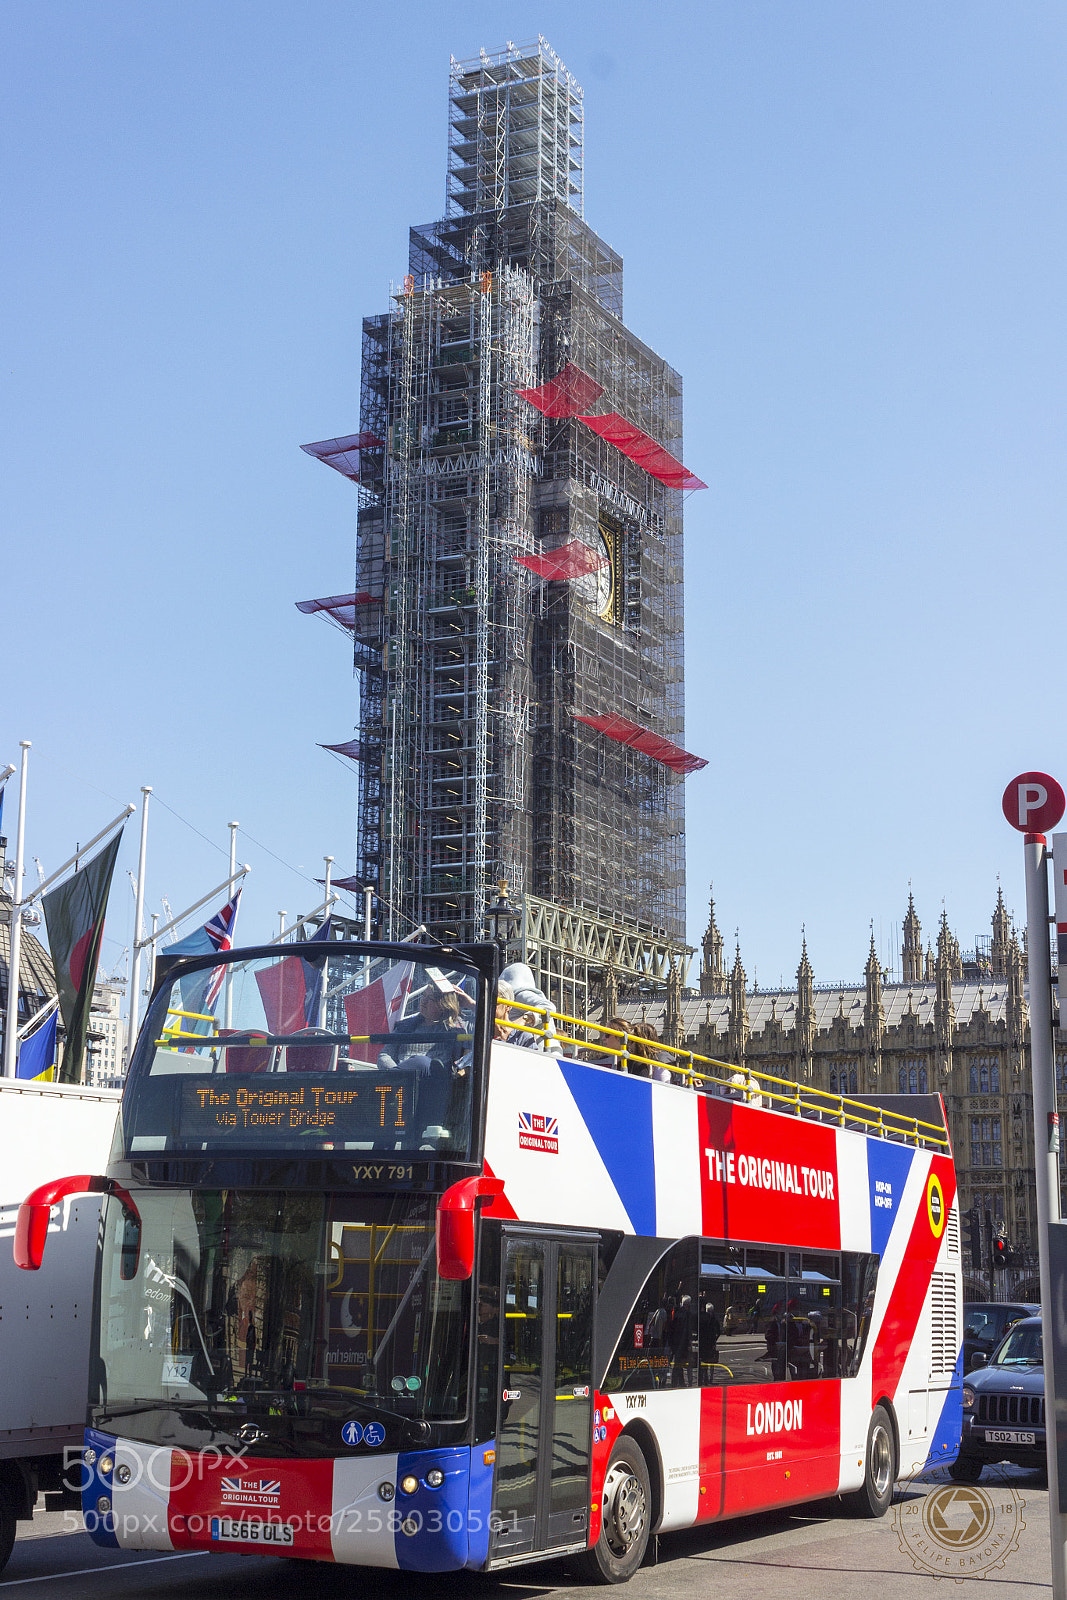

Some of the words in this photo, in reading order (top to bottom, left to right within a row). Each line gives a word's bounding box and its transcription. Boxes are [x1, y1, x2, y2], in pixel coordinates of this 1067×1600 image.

[1018, 783, 1048, 826] P
[197, 1089, 230, 1107] The
[236, 1088, 304, 1107] Original
[311, 1087, 358, 1106] Tour
[375, 1086, 405, 1126] T1
[216, 1111, 237, 1125] via
[242, 1108, 285, 1127] Tower
[289, 1108, 336, 1127] Bridge
[533, 1118, 544, 1129] THE
[520, 1135, 544, 1149] ORIGINAL
[544, 1139, 558, 1151] TOUR
[352, 1166, 383, 1179] YXY
[388, 1166, 413, 1179] 791
[704, 1148, 736, 1184] THE
[738, 1154, 802, 1195] ORIGINAL
[801, 1166, 835, 1200] TOUR
[625, 1395, 637, 1408] YXY
[746, 1399, 803, 1436] LONDON
[989, 1431, 1011, 1442] TS02
[1014, 1432, 1034, 1443] TCS
[243, 1481, 258, 1489] THE
[222, 1493, 258, 1503] ORIGINAL
[258, 1495, 279, 1504] TOUR
[221, 1521, 259, 1540] LS66
[263, 1524, 292, 1543] OLS
